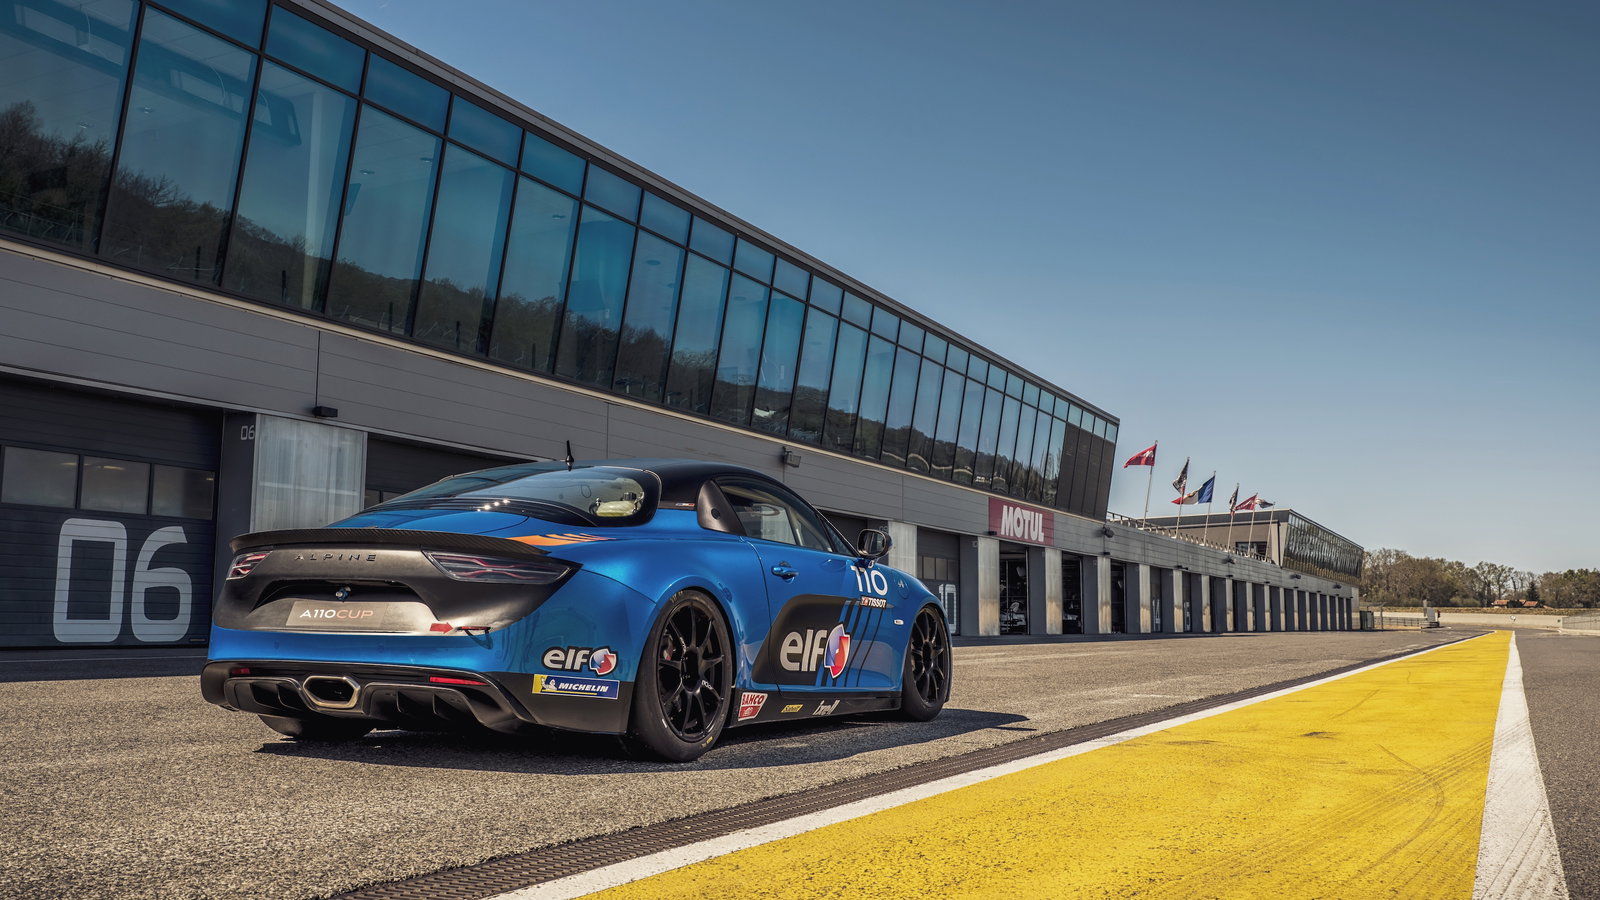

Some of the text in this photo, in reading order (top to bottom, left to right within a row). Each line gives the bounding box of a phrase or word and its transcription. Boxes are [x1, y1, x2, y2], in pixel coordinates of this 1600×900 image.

[240, 425, 255, 440] 06
[1000, 504, 1045, 542] MOTUL
[294, 553, 377, 562] ALPINE
[53, 518, 192, 643] 06
[850, 565, 888, 596] 110
[868, 597, 887, 608] TISSOT
[543, 648, 590, 671] elf
[780, 629, 828, 672] elf
[558, 682, 609, 692] MICHELIN
